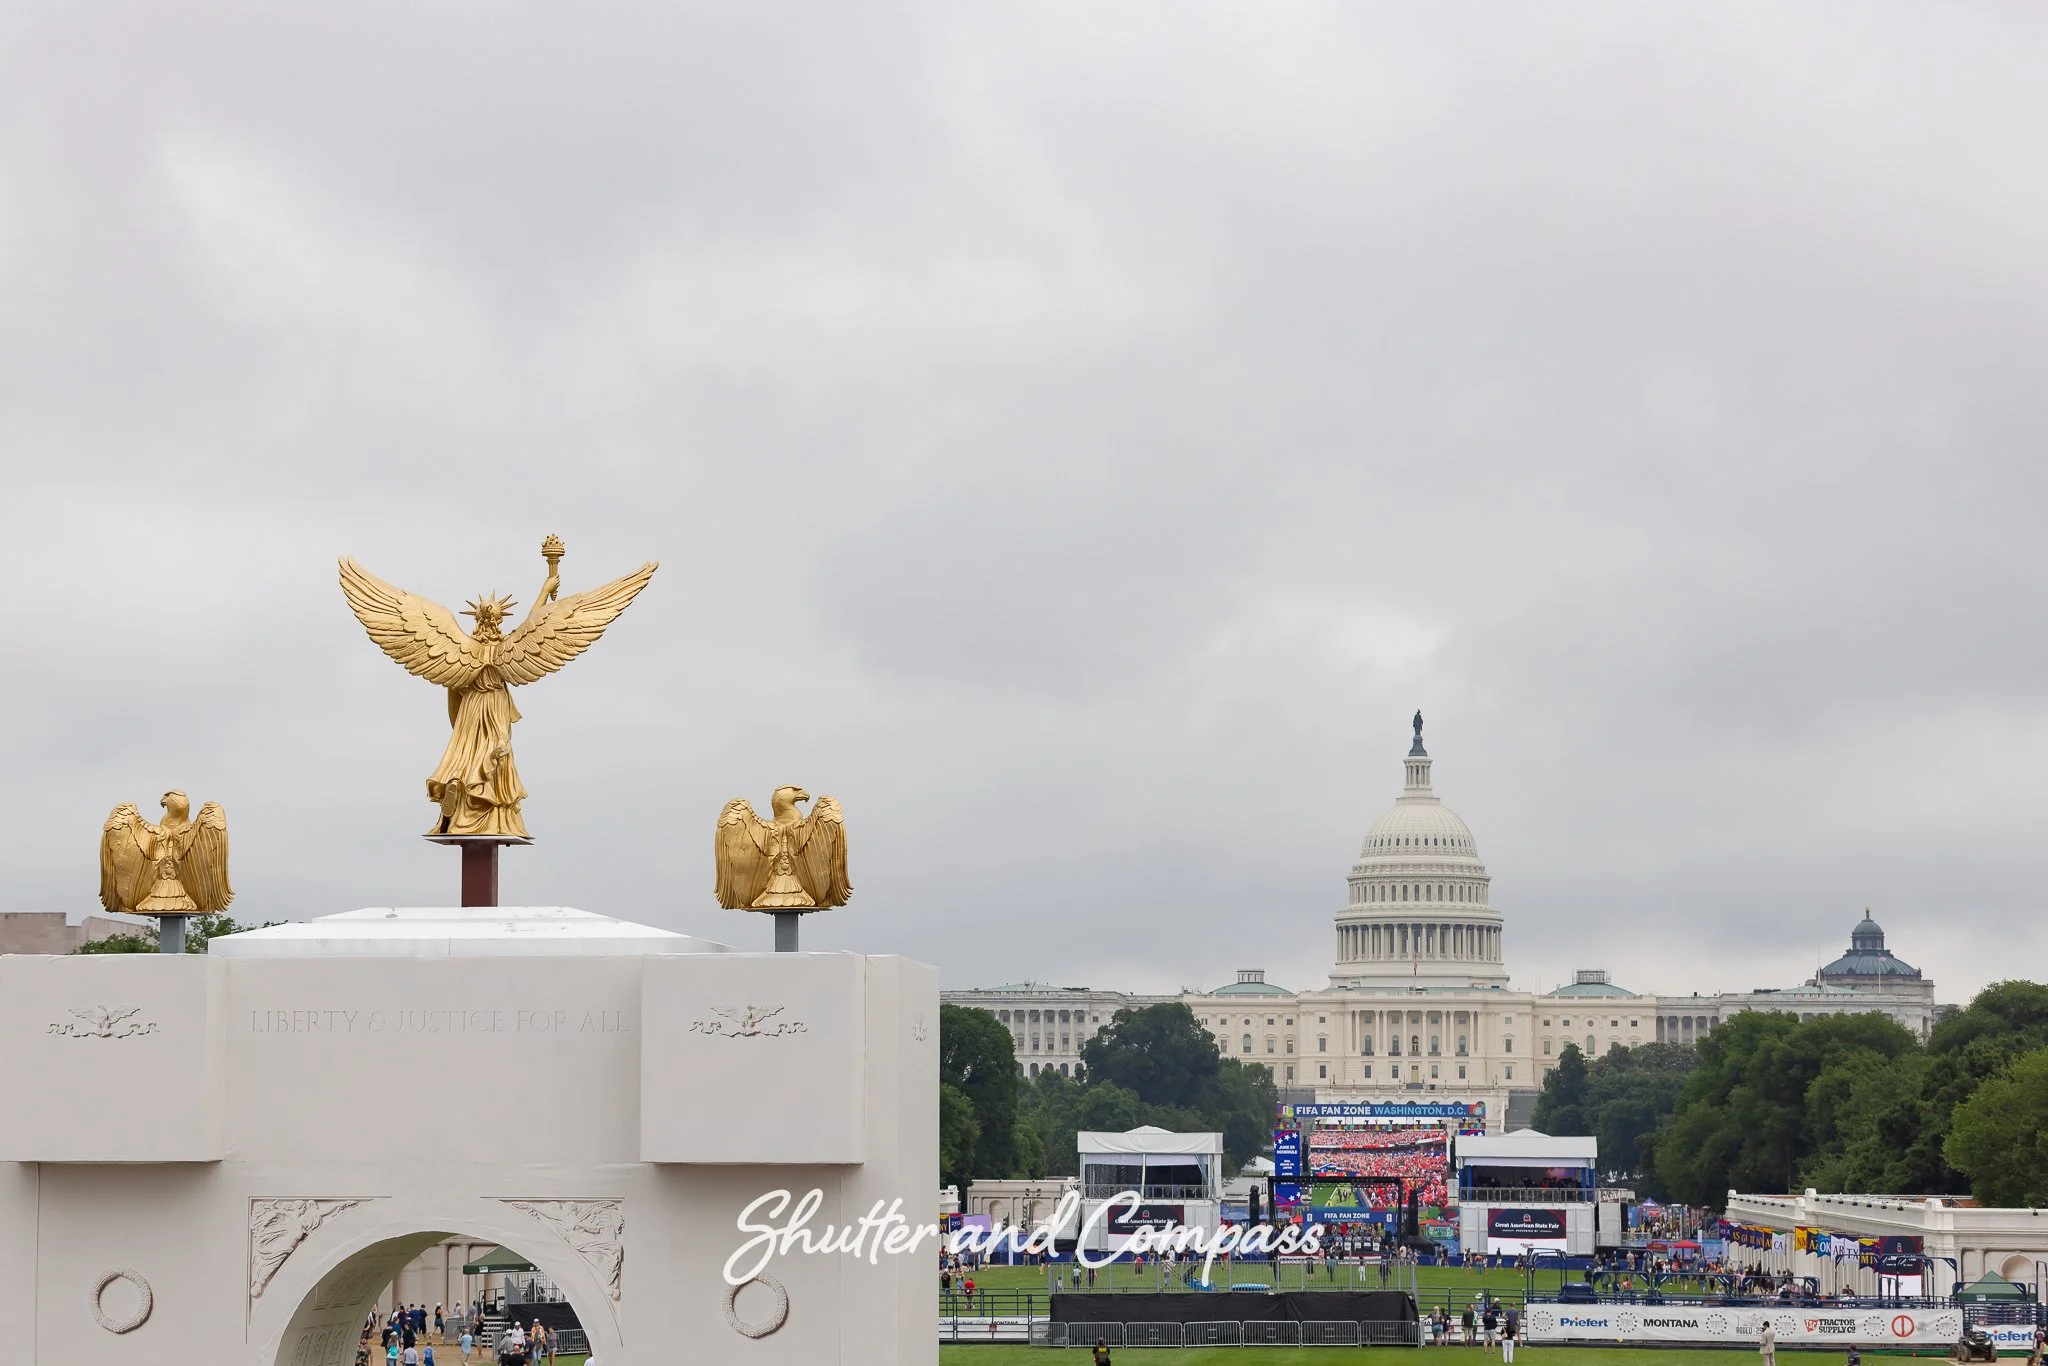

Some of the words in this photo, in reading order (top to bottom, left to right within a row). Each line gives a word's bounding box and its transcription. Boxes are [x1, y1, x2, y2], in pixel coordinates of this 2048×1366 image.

[251, 1010, 359, 1032] LIBERTY
[367, 1010, 386, 1032] &
[397, 1010, 503, 1032] JUSTICE
[516, 1010, 567, 1032] FOR
[580, 1008, 629, 1032] ALL
[1296, 1106, 1318, 1115] FIFA
[1321, 1106, 1340, 1115] FAN
[1343, 1106, 1371, 1115] ZONE
[1374, 1106, 1445, 1116] WASHINGTON,
[1447, 1106, 1467, 1115] D.C.
[1774, 1241, 1784, 1250] CA
[1847, 1249, 1859, 1260] TX
[1861, 1252, 1873, 1264] MT
[1560, 1316, 1608, 1328] Priefert
[1643, 1318, 1699, 1328] MONTANA
